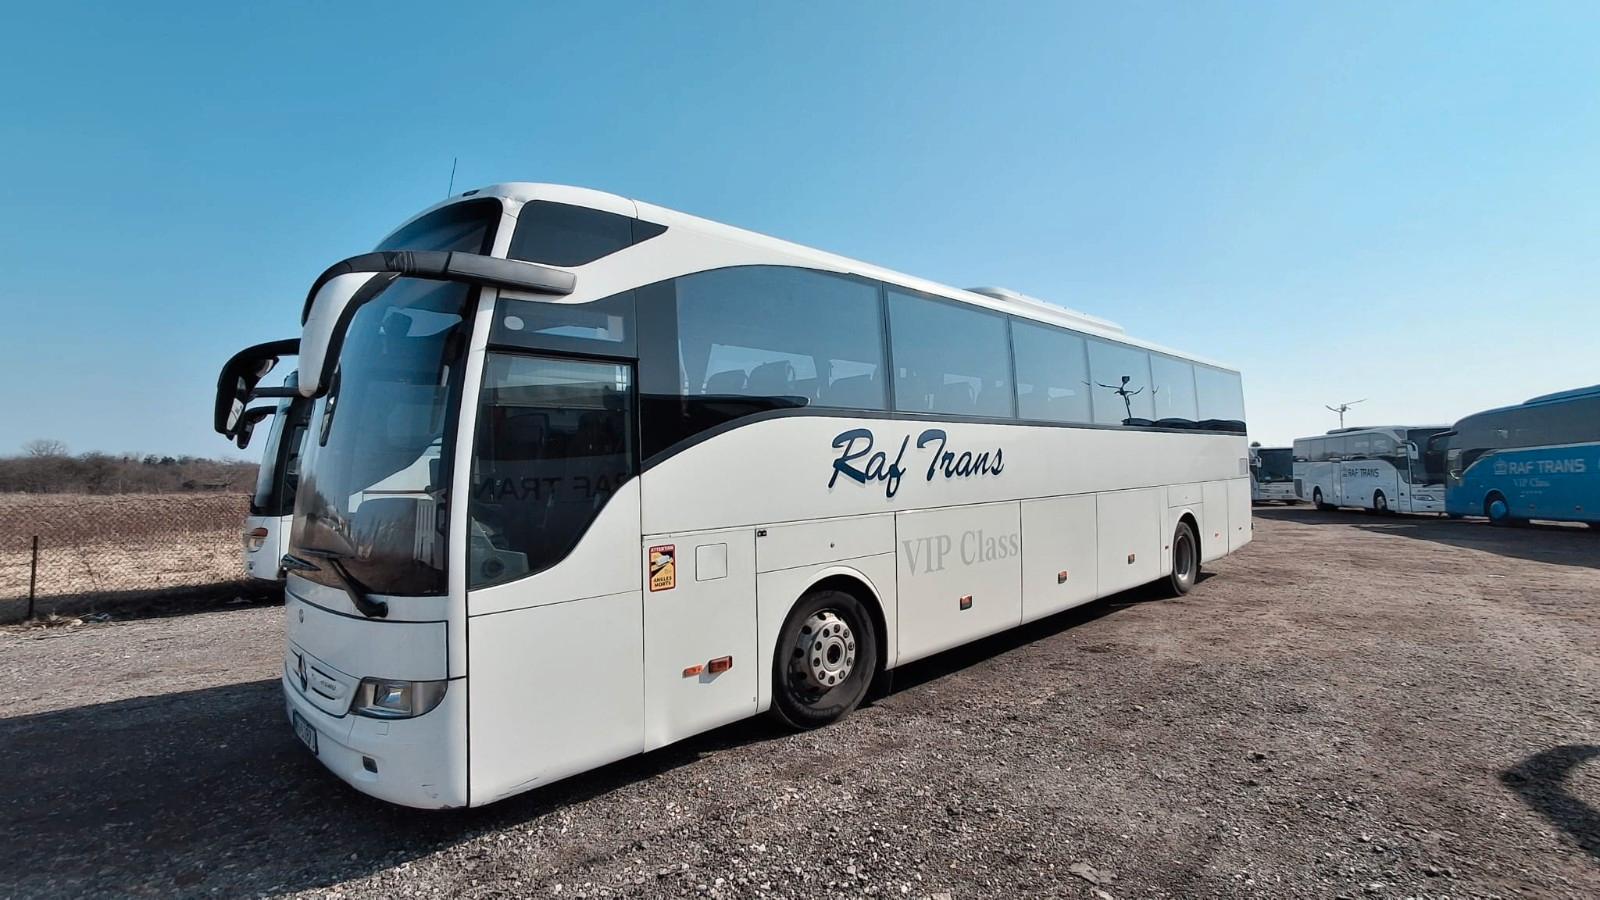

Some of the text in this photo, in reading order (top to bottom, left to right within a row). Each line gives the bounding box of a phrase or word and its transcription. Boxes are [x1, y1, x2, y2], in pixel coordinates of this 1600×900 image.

[828, 428, 1004, 498] Raf Trans
[1509, 458, 1586, 474] RAF TRANS
[902, 529, 1018, 576] VIP Class
